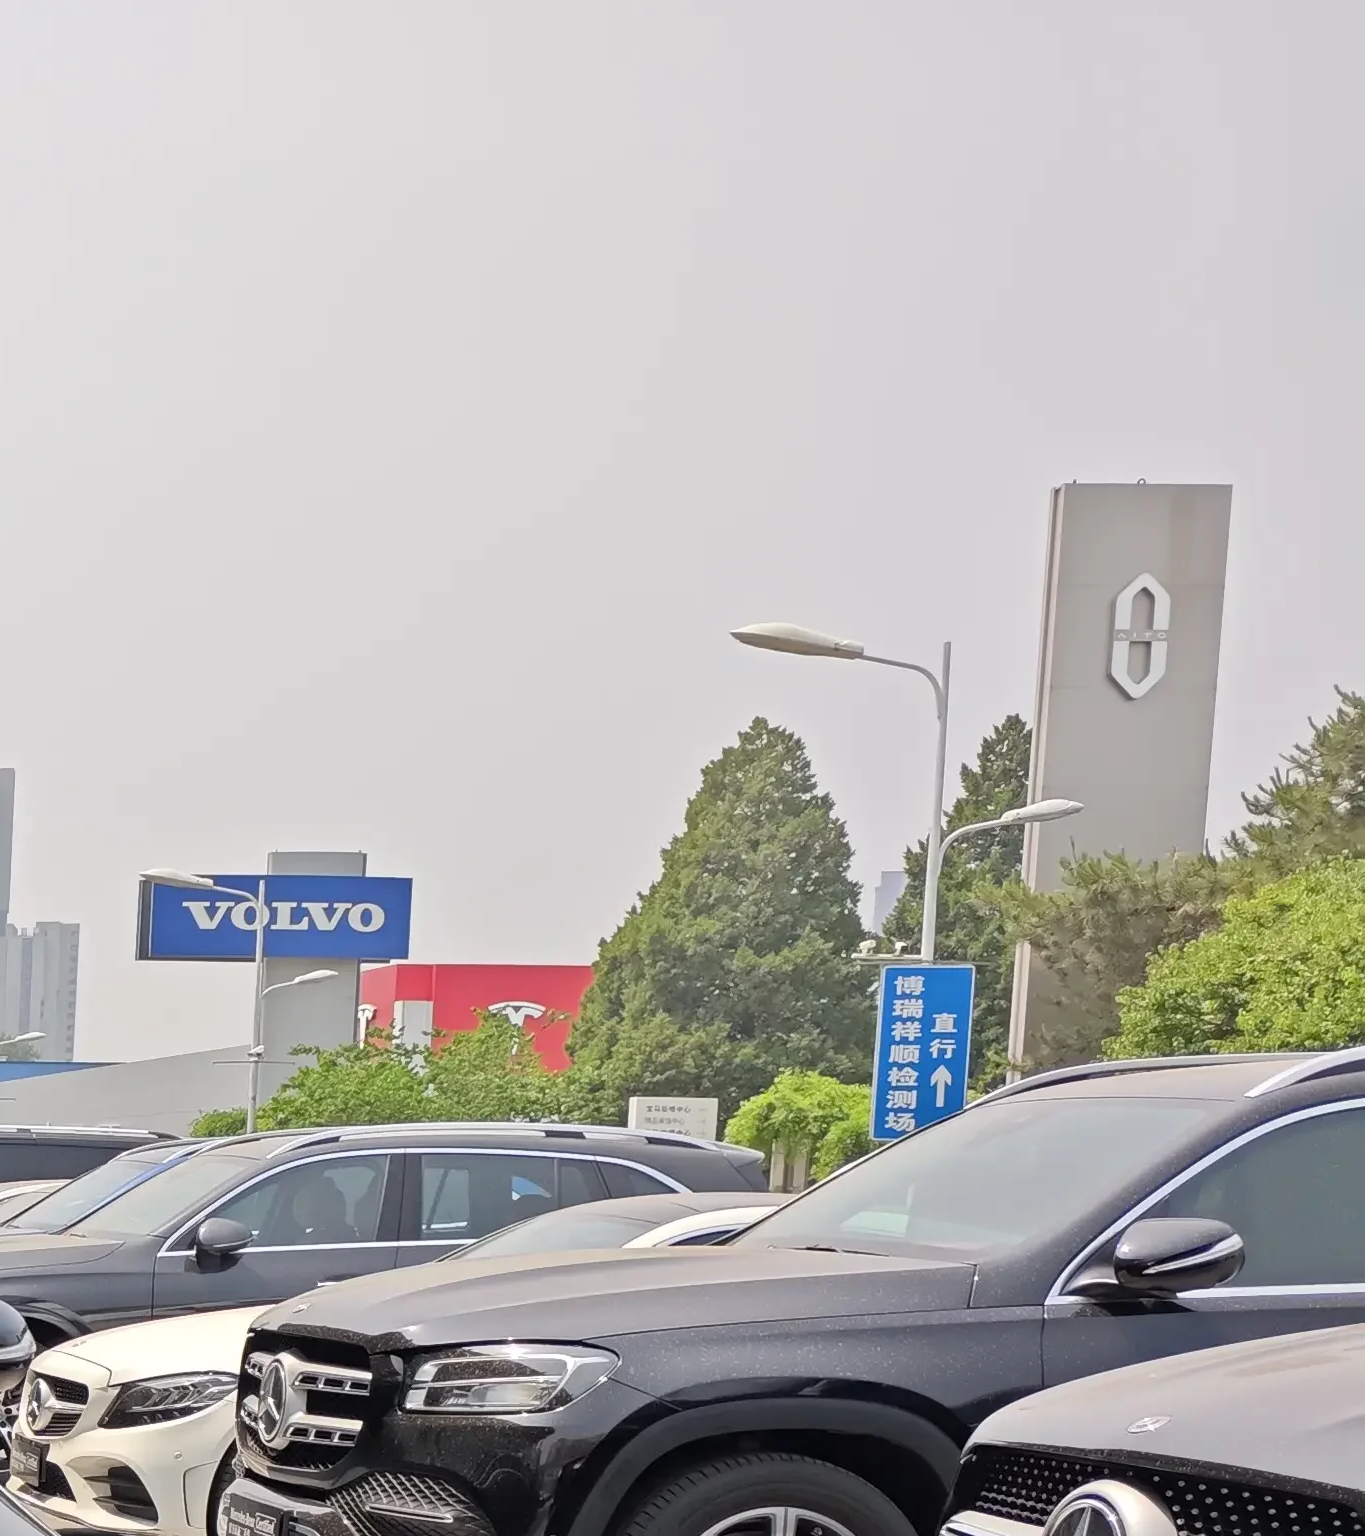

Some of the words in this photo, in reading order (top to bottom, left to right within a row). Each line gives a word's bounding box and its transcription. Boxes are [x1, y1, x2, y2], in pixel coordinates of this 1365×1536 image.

[182, 900, 385, 933] VOLVO
[884, 975, 926, 1132] 博瑞祥顺检测场
[929, 1012, 958, 1059] 直行
